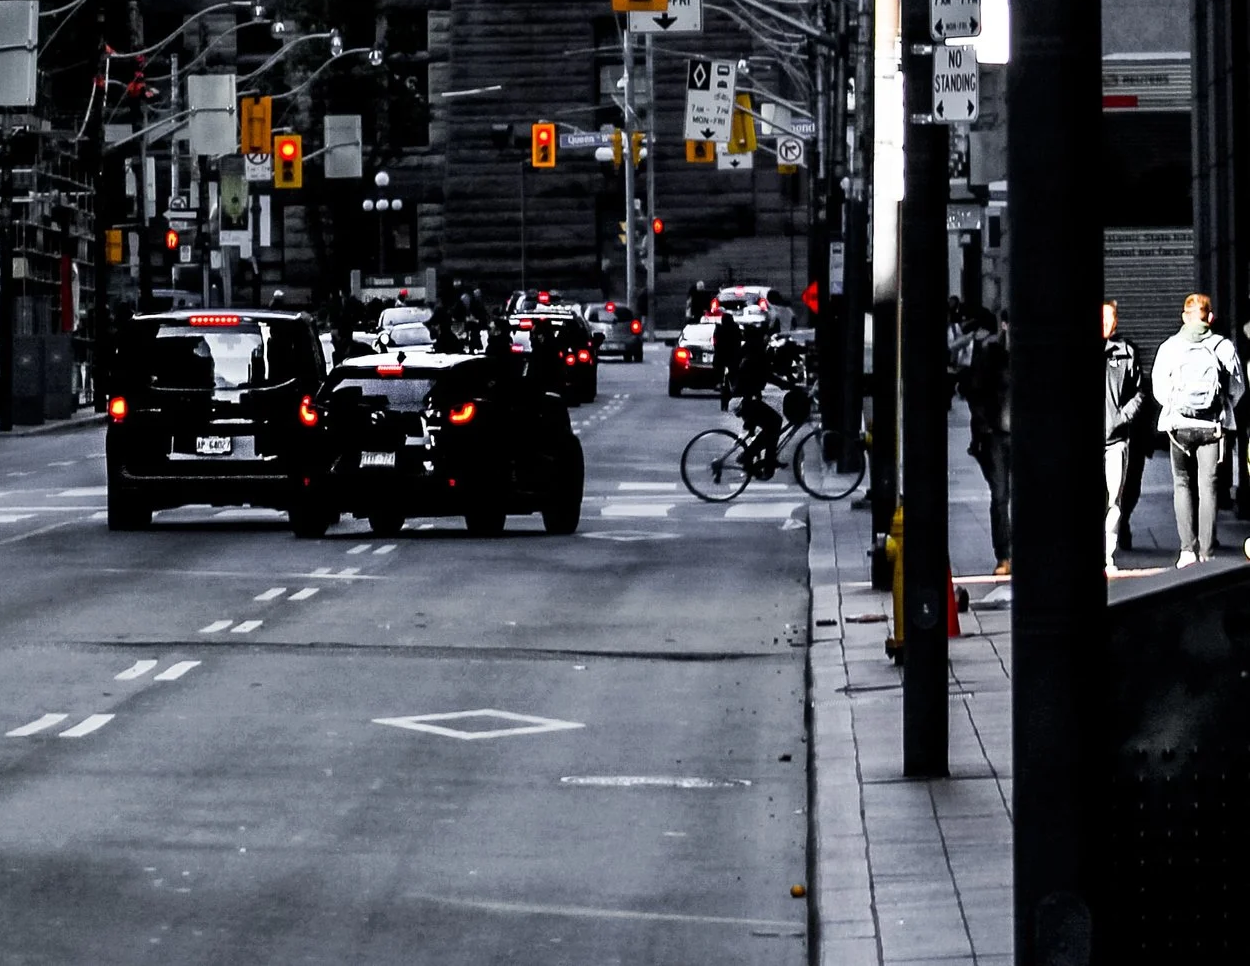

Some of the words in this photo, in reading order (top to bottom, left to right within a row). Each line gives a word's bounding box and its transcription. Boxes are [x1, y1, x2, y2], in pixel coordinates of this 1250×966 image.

[948, 50, 962, 68] NO
[934, 73, 976, 93] STANDING
[567, 136, 595, 146] Queen
